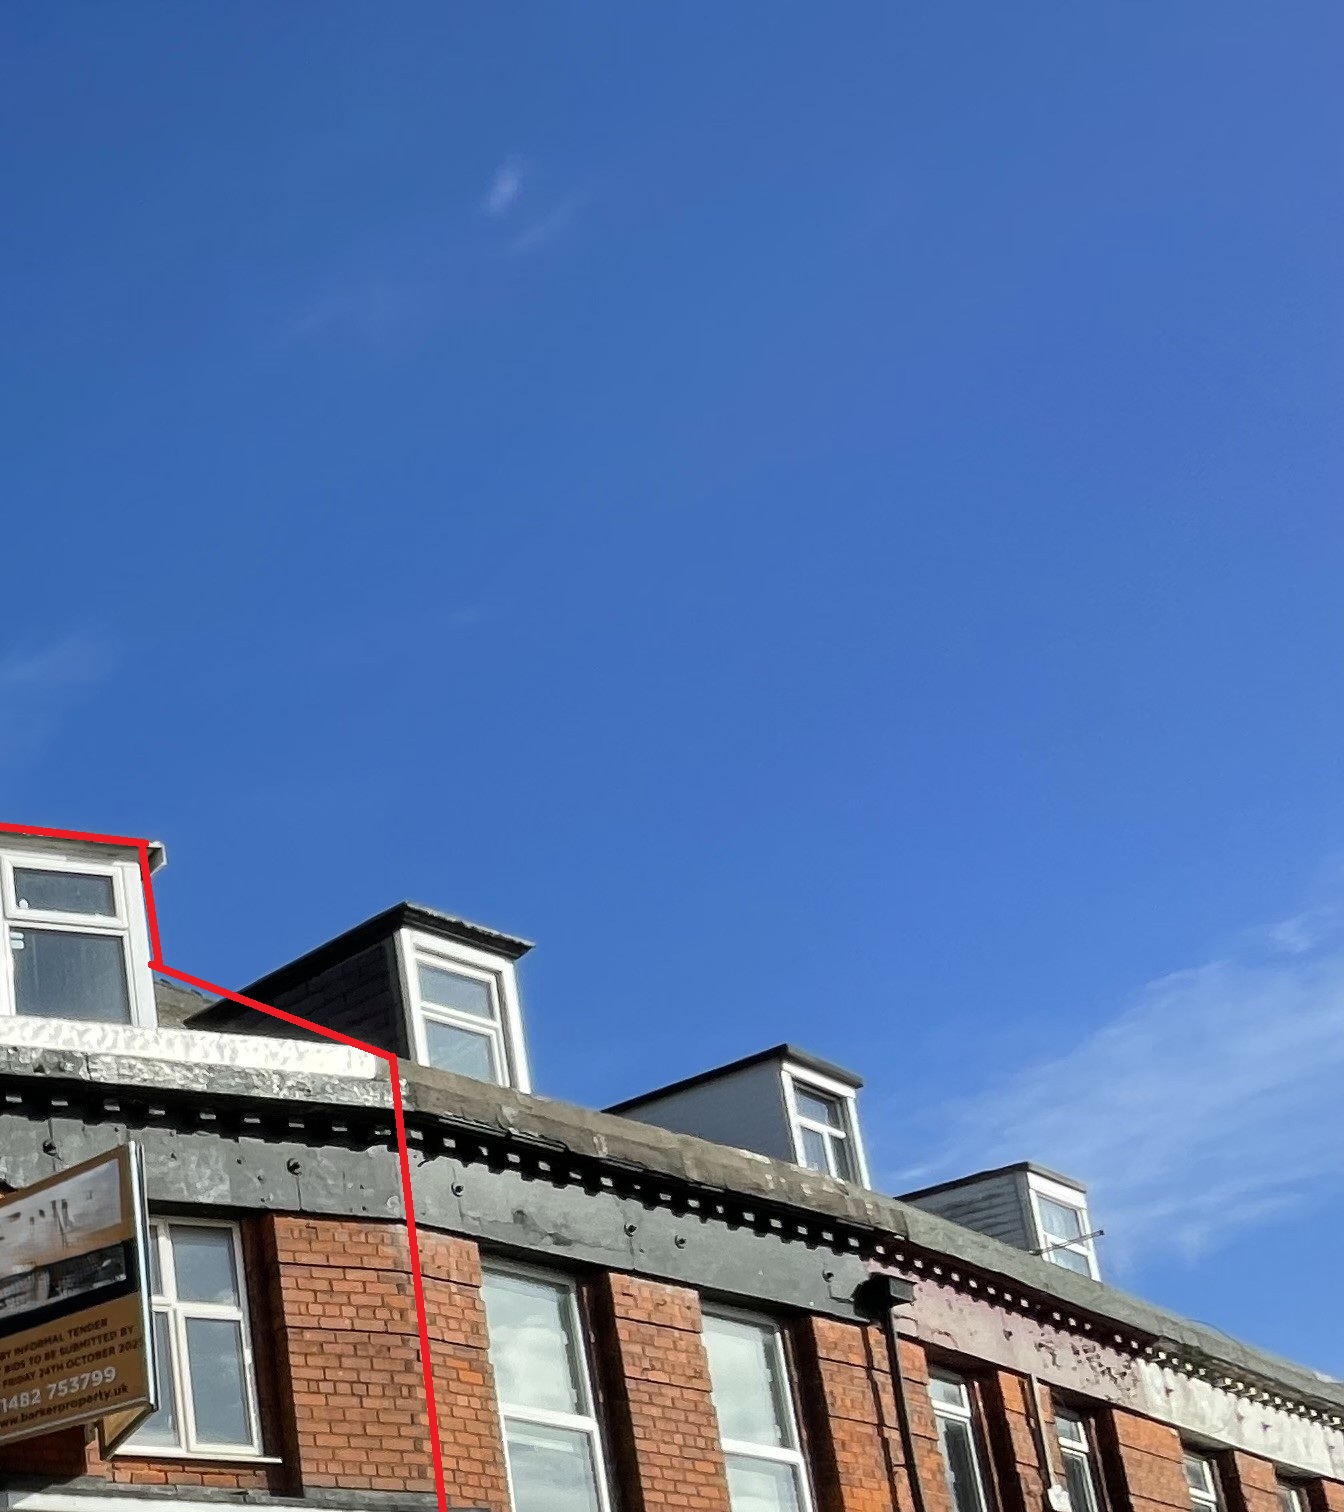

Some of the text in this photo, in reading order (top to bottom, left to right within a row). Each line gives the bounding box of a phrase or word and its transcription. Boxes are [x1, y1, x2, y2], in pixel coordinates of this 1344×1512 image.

[0, 1318, 108, 1361] BY INFORMAL TENDER
[28, 1356, 42, 1367] TO
[44, 1350, 57, 1362] BE
[60, 1330, 117, 1356] SUBMITTED
[120, 1325, 135, 1336] BY
[2, 1371, 36, 1389] FRIDAY
[65, 1346, 116, 1370] OCTOBER
[47, 1366, 116, 1400] 753799
